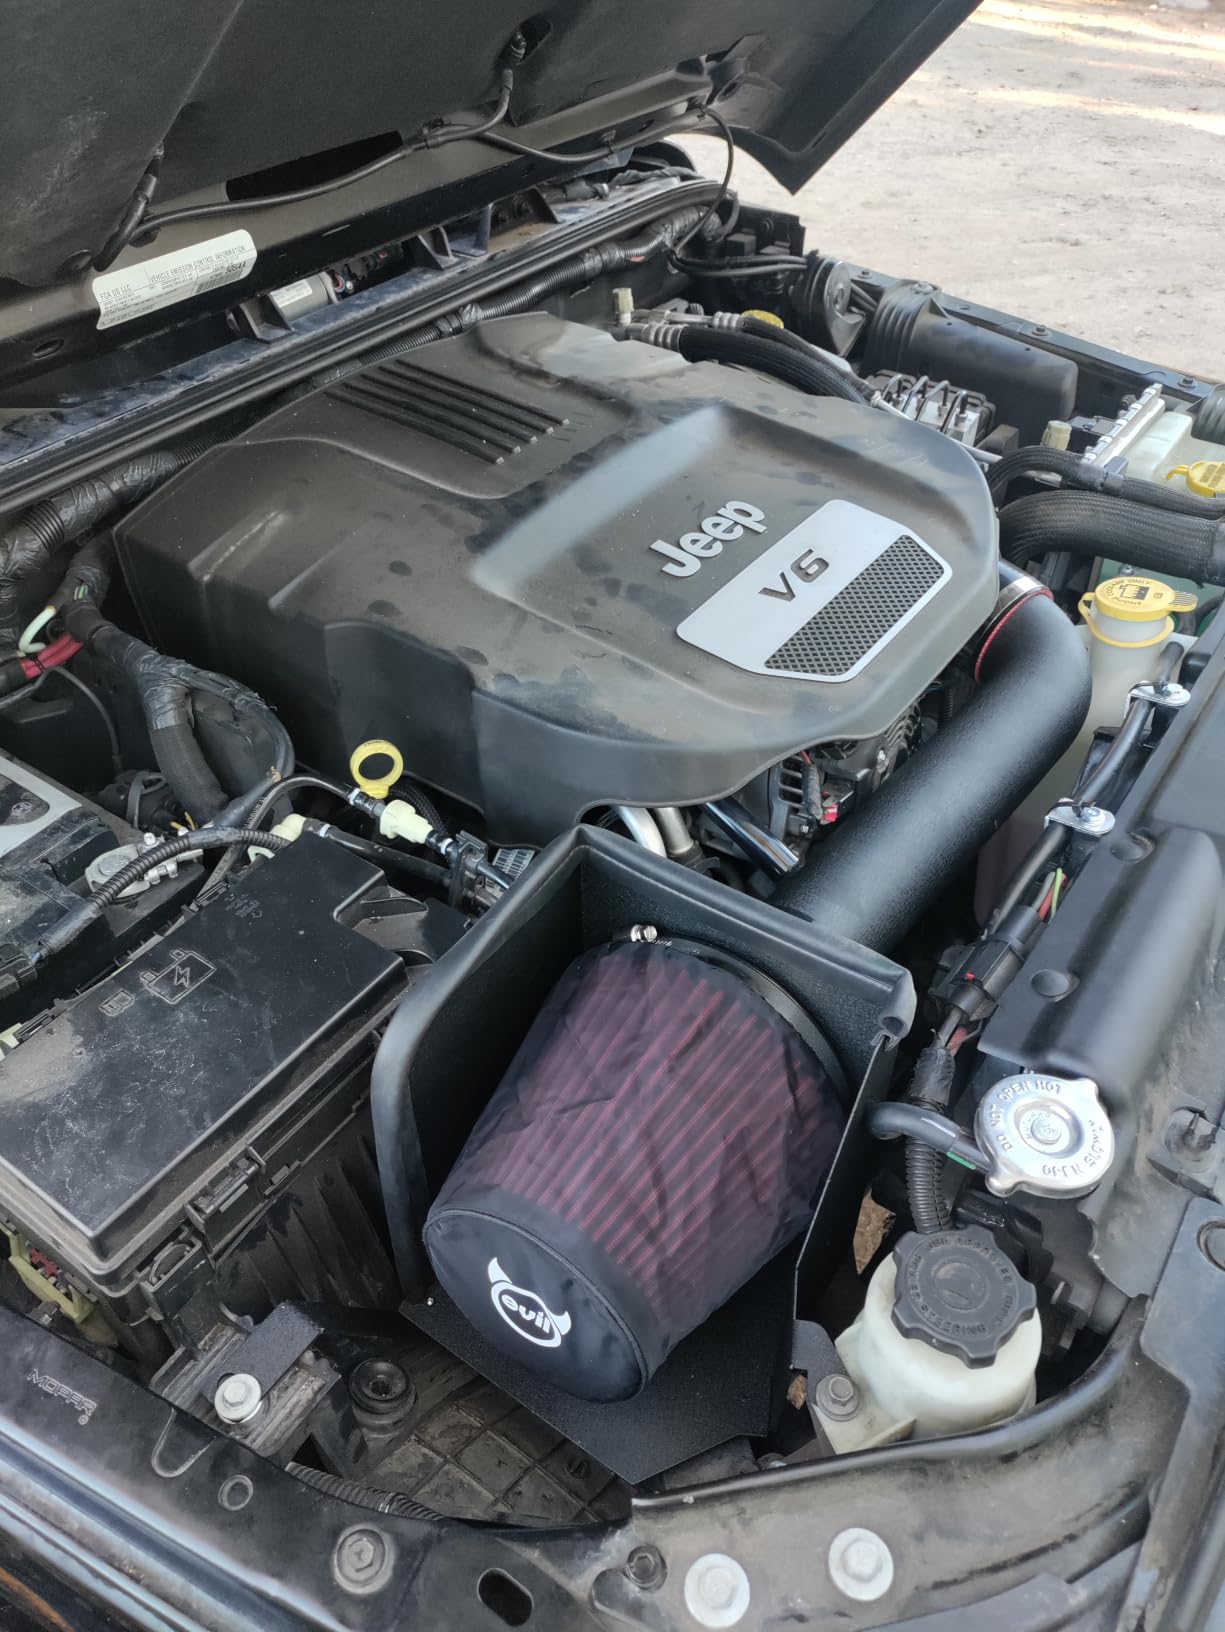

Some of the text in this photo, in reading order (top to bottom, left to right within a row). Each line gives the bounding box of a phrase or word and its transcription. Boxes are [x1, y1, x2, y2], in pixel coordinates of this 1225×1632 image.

[151, 270, 170, 283] VEHICLE
[170, 263, 194, 275] EMISSION
[193, 255, 214, 268] CONTROL
[215, 245, 246, 259] INFORMATION
[649, 500, 768, 578] Jeep
[758, 548, 830, 602] V6
[997, 1081, 1030, 1102] OPEN
[990, 1103, 1003, 1127] NOT
[996, 1134, 1013, 1153] DO
[920, 1303, 987, 1336] STEERING
[26, 1368, 98, 1416] MOPAR
